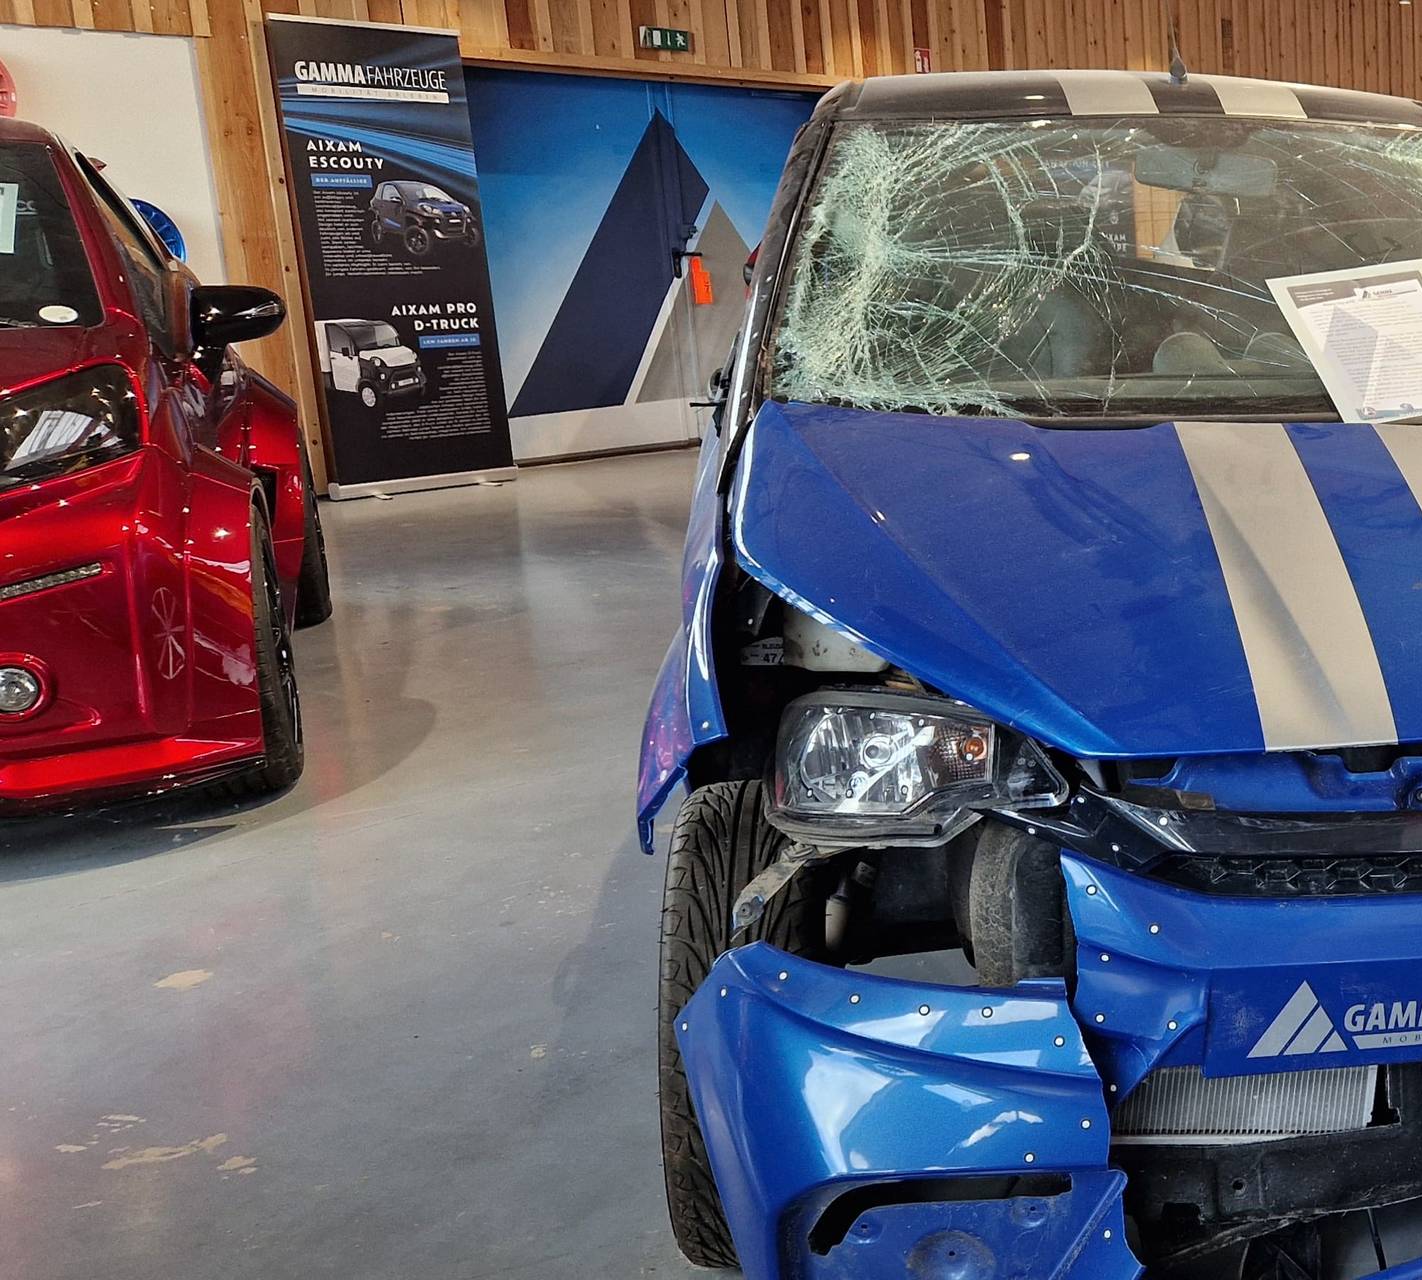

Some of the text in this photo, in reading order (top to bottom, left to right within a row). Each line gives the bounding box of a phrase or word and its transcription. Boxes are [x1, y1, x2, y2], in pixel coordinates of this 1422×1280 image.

[306, 139, 362, 153] AIXAM
[308, 156, 384, 170] ESCOUTY
[391, 302, 477, 317] AIXAM PRO
[414, 318, 479, 331] D-TRUCK
